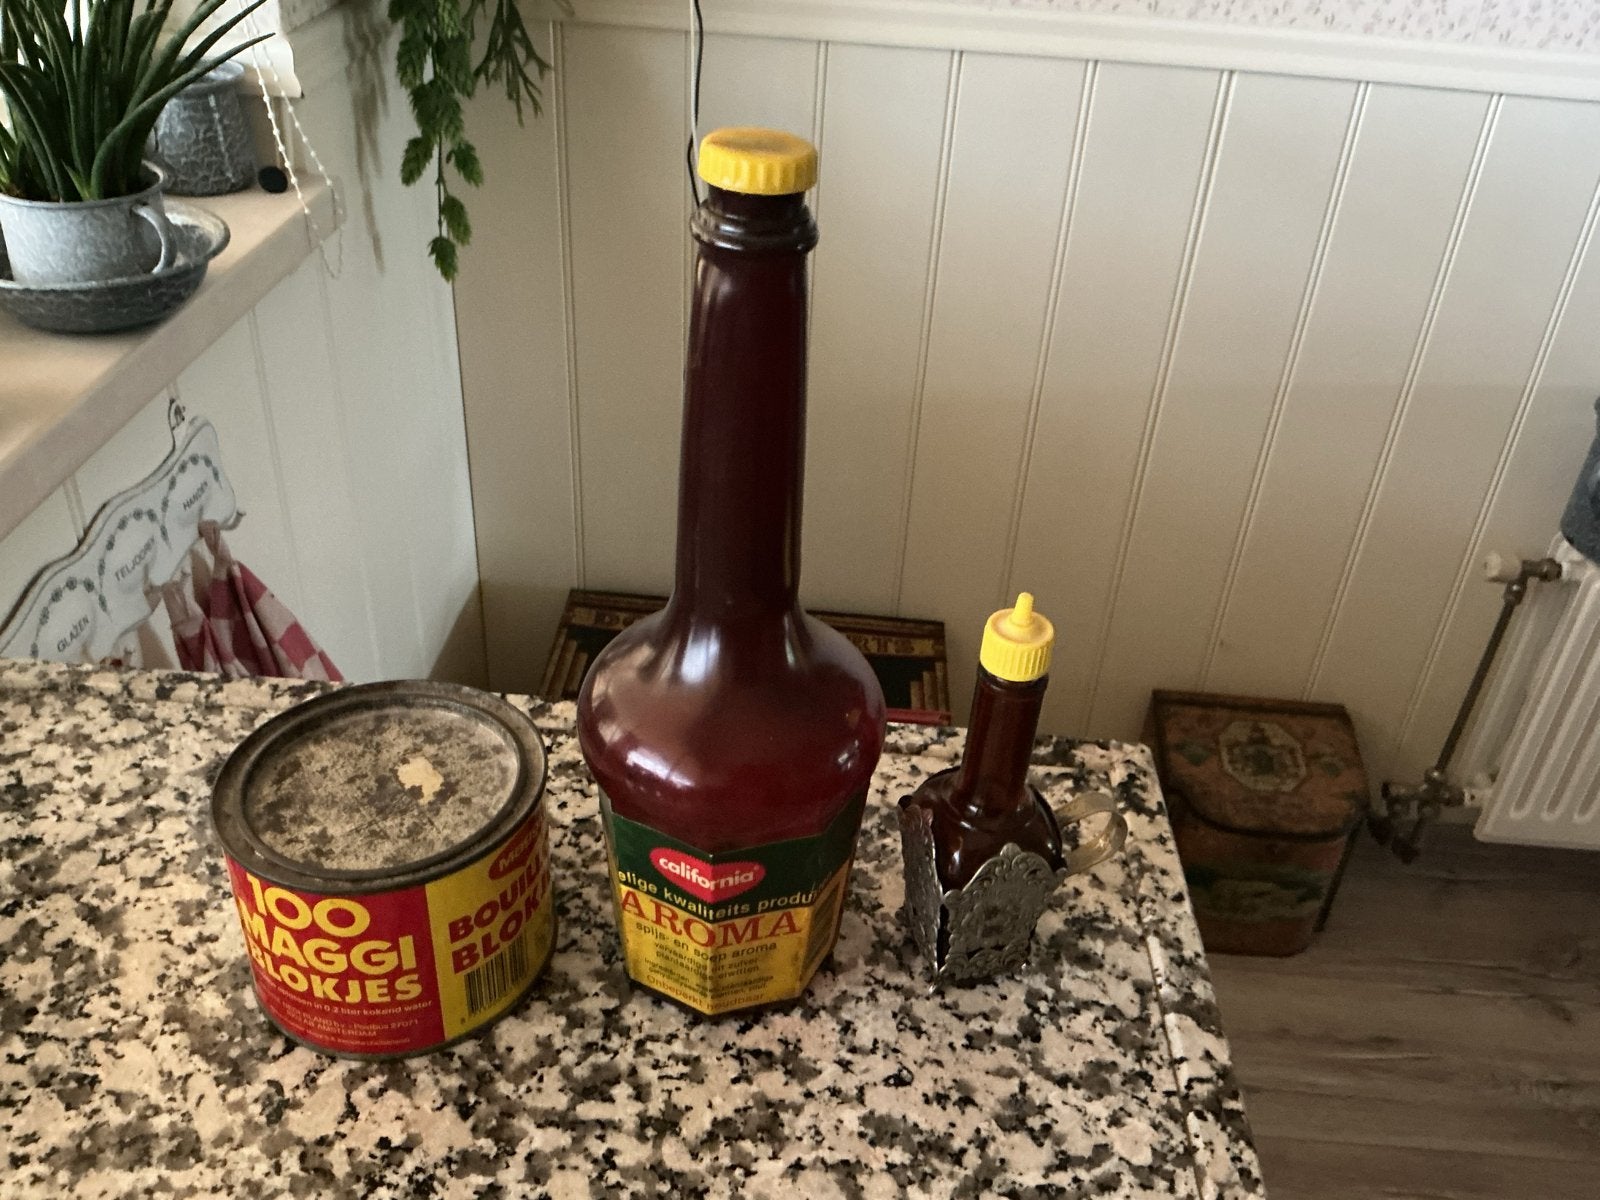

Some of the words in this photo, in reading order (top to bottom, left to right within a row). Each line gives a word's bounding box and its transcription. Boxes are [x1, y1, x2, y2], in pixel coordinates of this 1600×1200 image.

[658, 856, 754, 892] california
[246, 872, 371, 938] 100
[620, 889, 801, 950] AROMA
[663, 886, 751, 921] kwaliteits
[238, 896, 417, 975] MAGGI
[673, 938, 690, 950] en
[693, 947, 728, 963] soep
[732, 942, 778, 959] aroma
[247, 935, 422, 1004] BLOKJES
[363, 1005, 402, 1017] kokend
[404, 1000, 432, 1013] water
